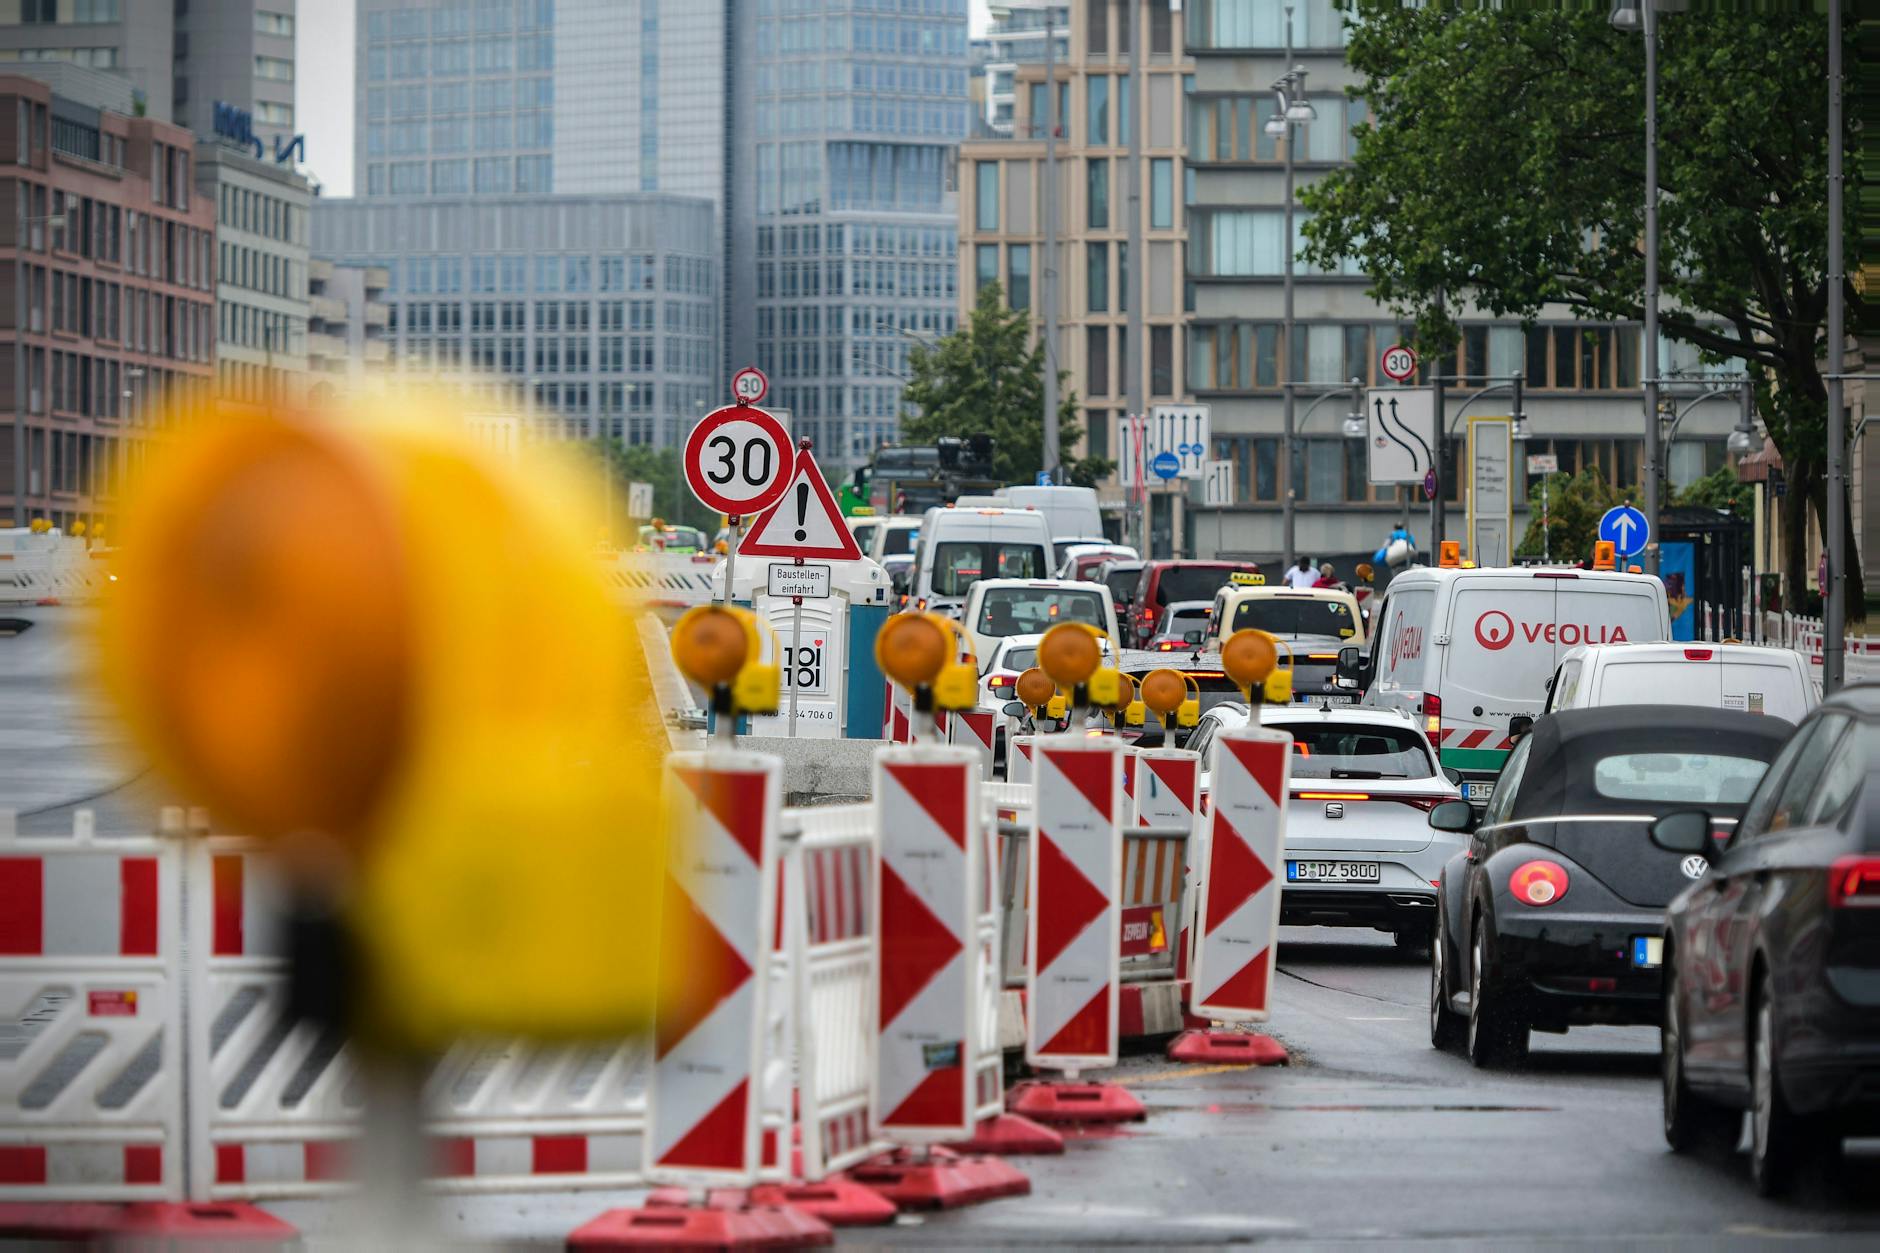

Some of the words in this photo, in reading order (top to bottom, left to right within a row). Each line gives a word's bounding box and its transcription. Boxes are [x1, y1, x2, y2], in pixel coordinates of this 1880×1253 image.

[1389, 354, 1410, 371] 30
[739, 377, 760, 394] 30
[707, 435, 771, 486] 30
[777, 568, 825, 580] Baustellen-
[781, 583, 815, 595] einfahrt
[808, 710, 825, 719] 706
[827, 711, 833, 720] 0
[1470, 785, 1477, 797] B
[1298, 863, 1307, 877] B
[1318, 863, 1337, 878] DZ
[1340, 864, 1377, 878] 5800
